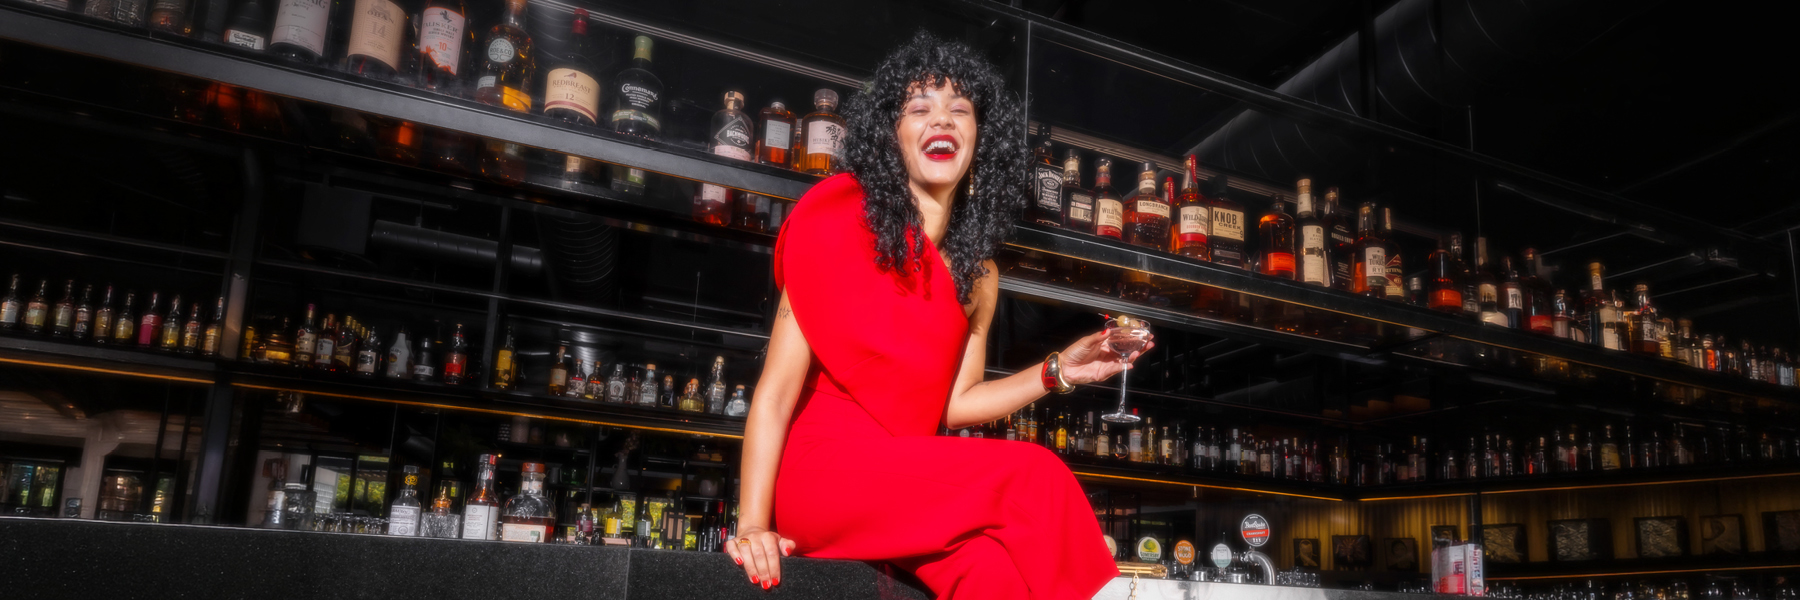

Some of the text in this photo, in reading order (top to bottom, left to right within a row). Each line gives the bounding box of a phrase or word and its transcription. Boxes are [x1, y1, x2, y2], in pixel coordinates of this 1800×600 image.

[367, 10, 394, 24] OBAN
[372, 21, 386, 38] 14
[422, 21, 460, 34] TALISKER
[438, 41, 447, 52] 10
[552, 79, 591, 94] REDBREAST
[565, 93, 575, 101] 12
[1139, 201, 1168, 211] LONGBRANCH
[1214, 210, 1237, 225] KNOB
[1218, 222, 1241, 230] CREEK
